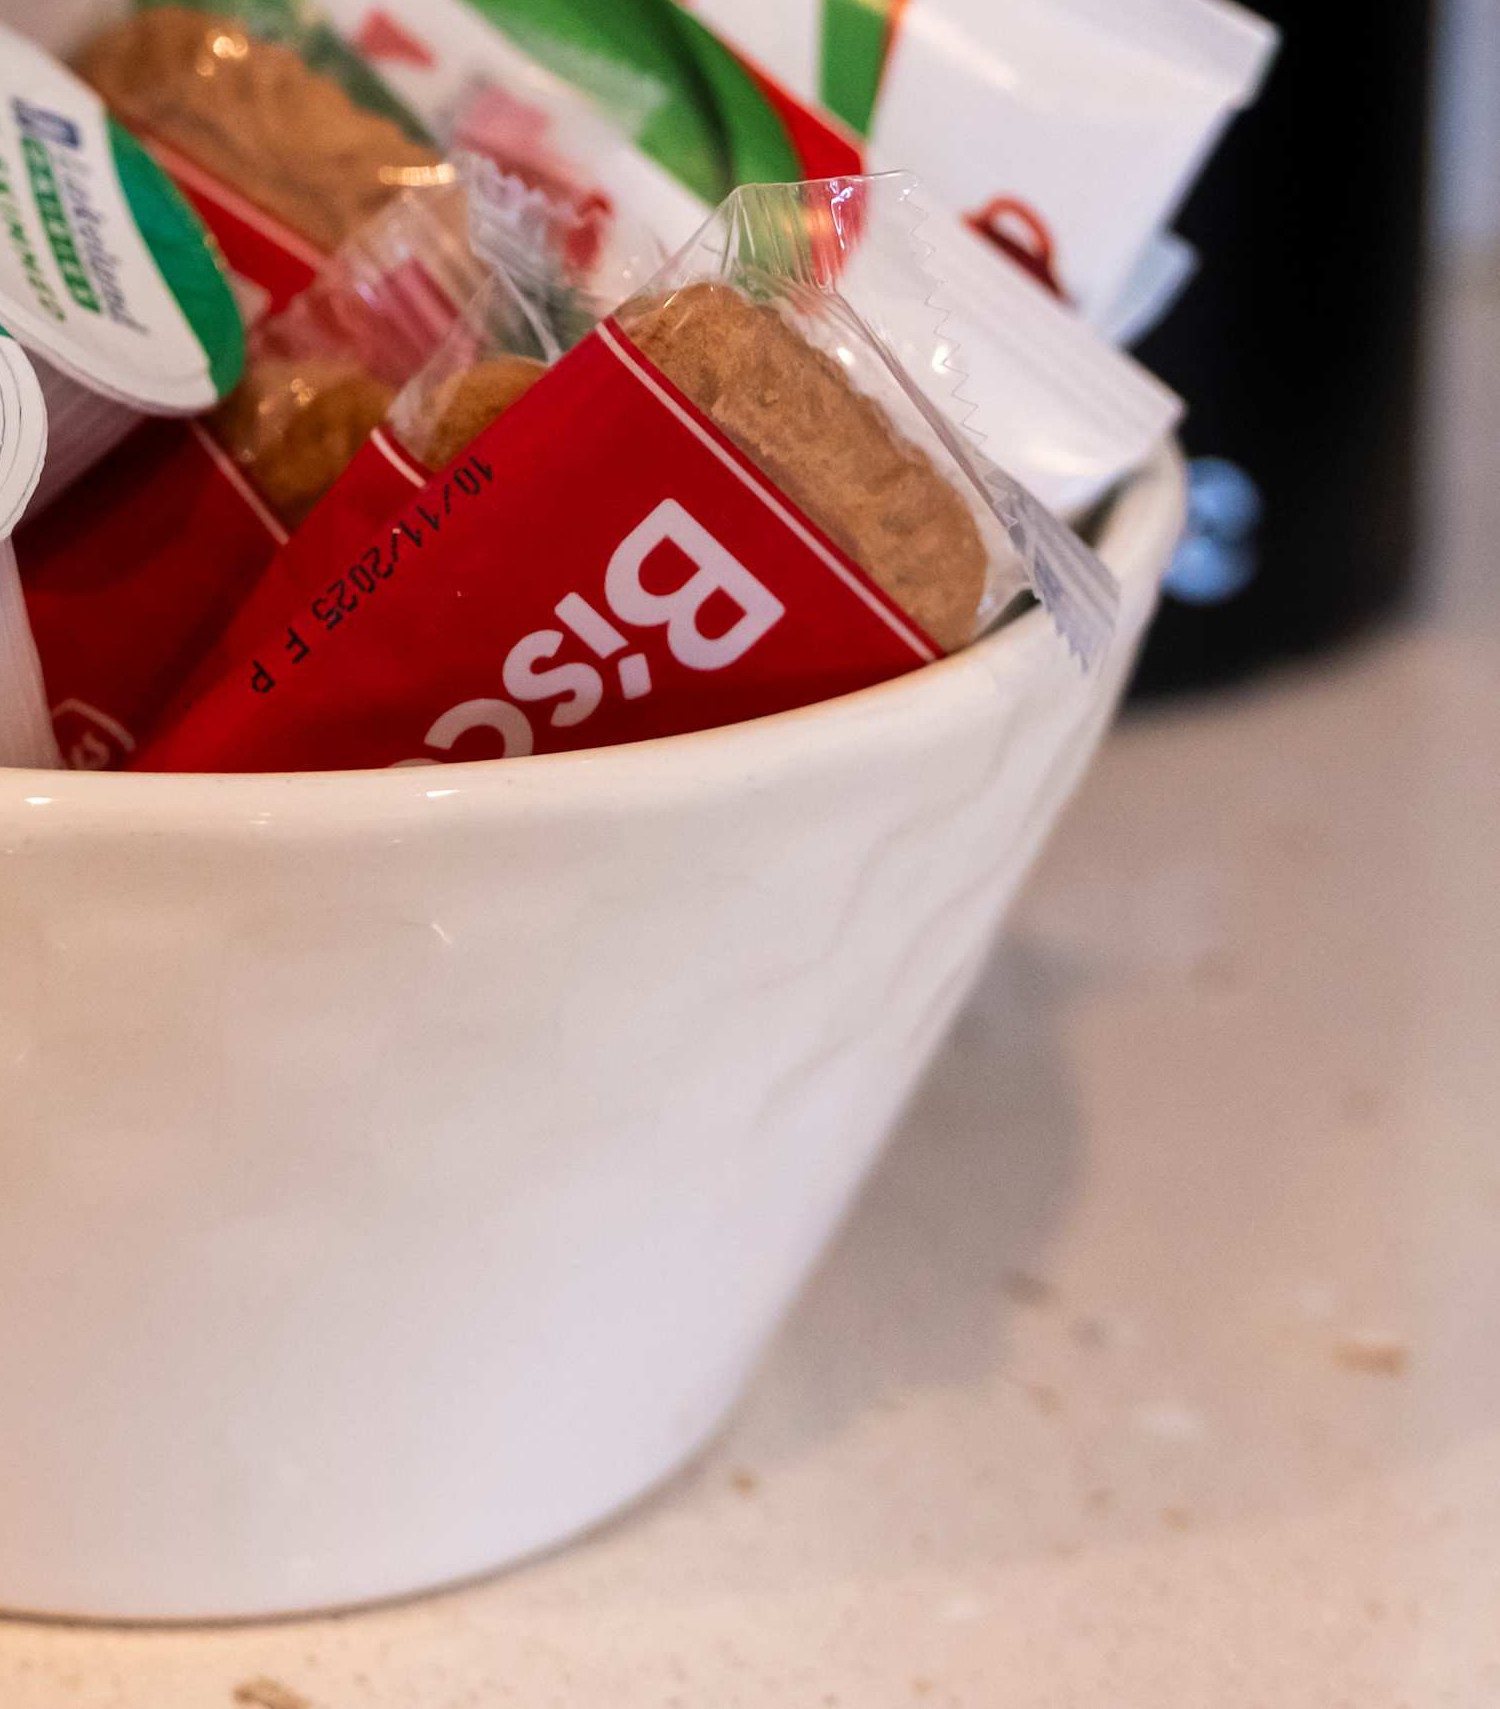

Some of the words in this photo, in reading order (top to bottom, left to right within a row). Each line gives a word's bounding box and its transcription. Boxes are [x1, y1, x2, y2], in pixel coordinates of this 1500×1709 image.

[311, 455, 494, 630] 10/11/2025
[251, 659, 276, 694] P
[285, 626, 311, 665] F
[387, 498, 787, 769] Bisc
